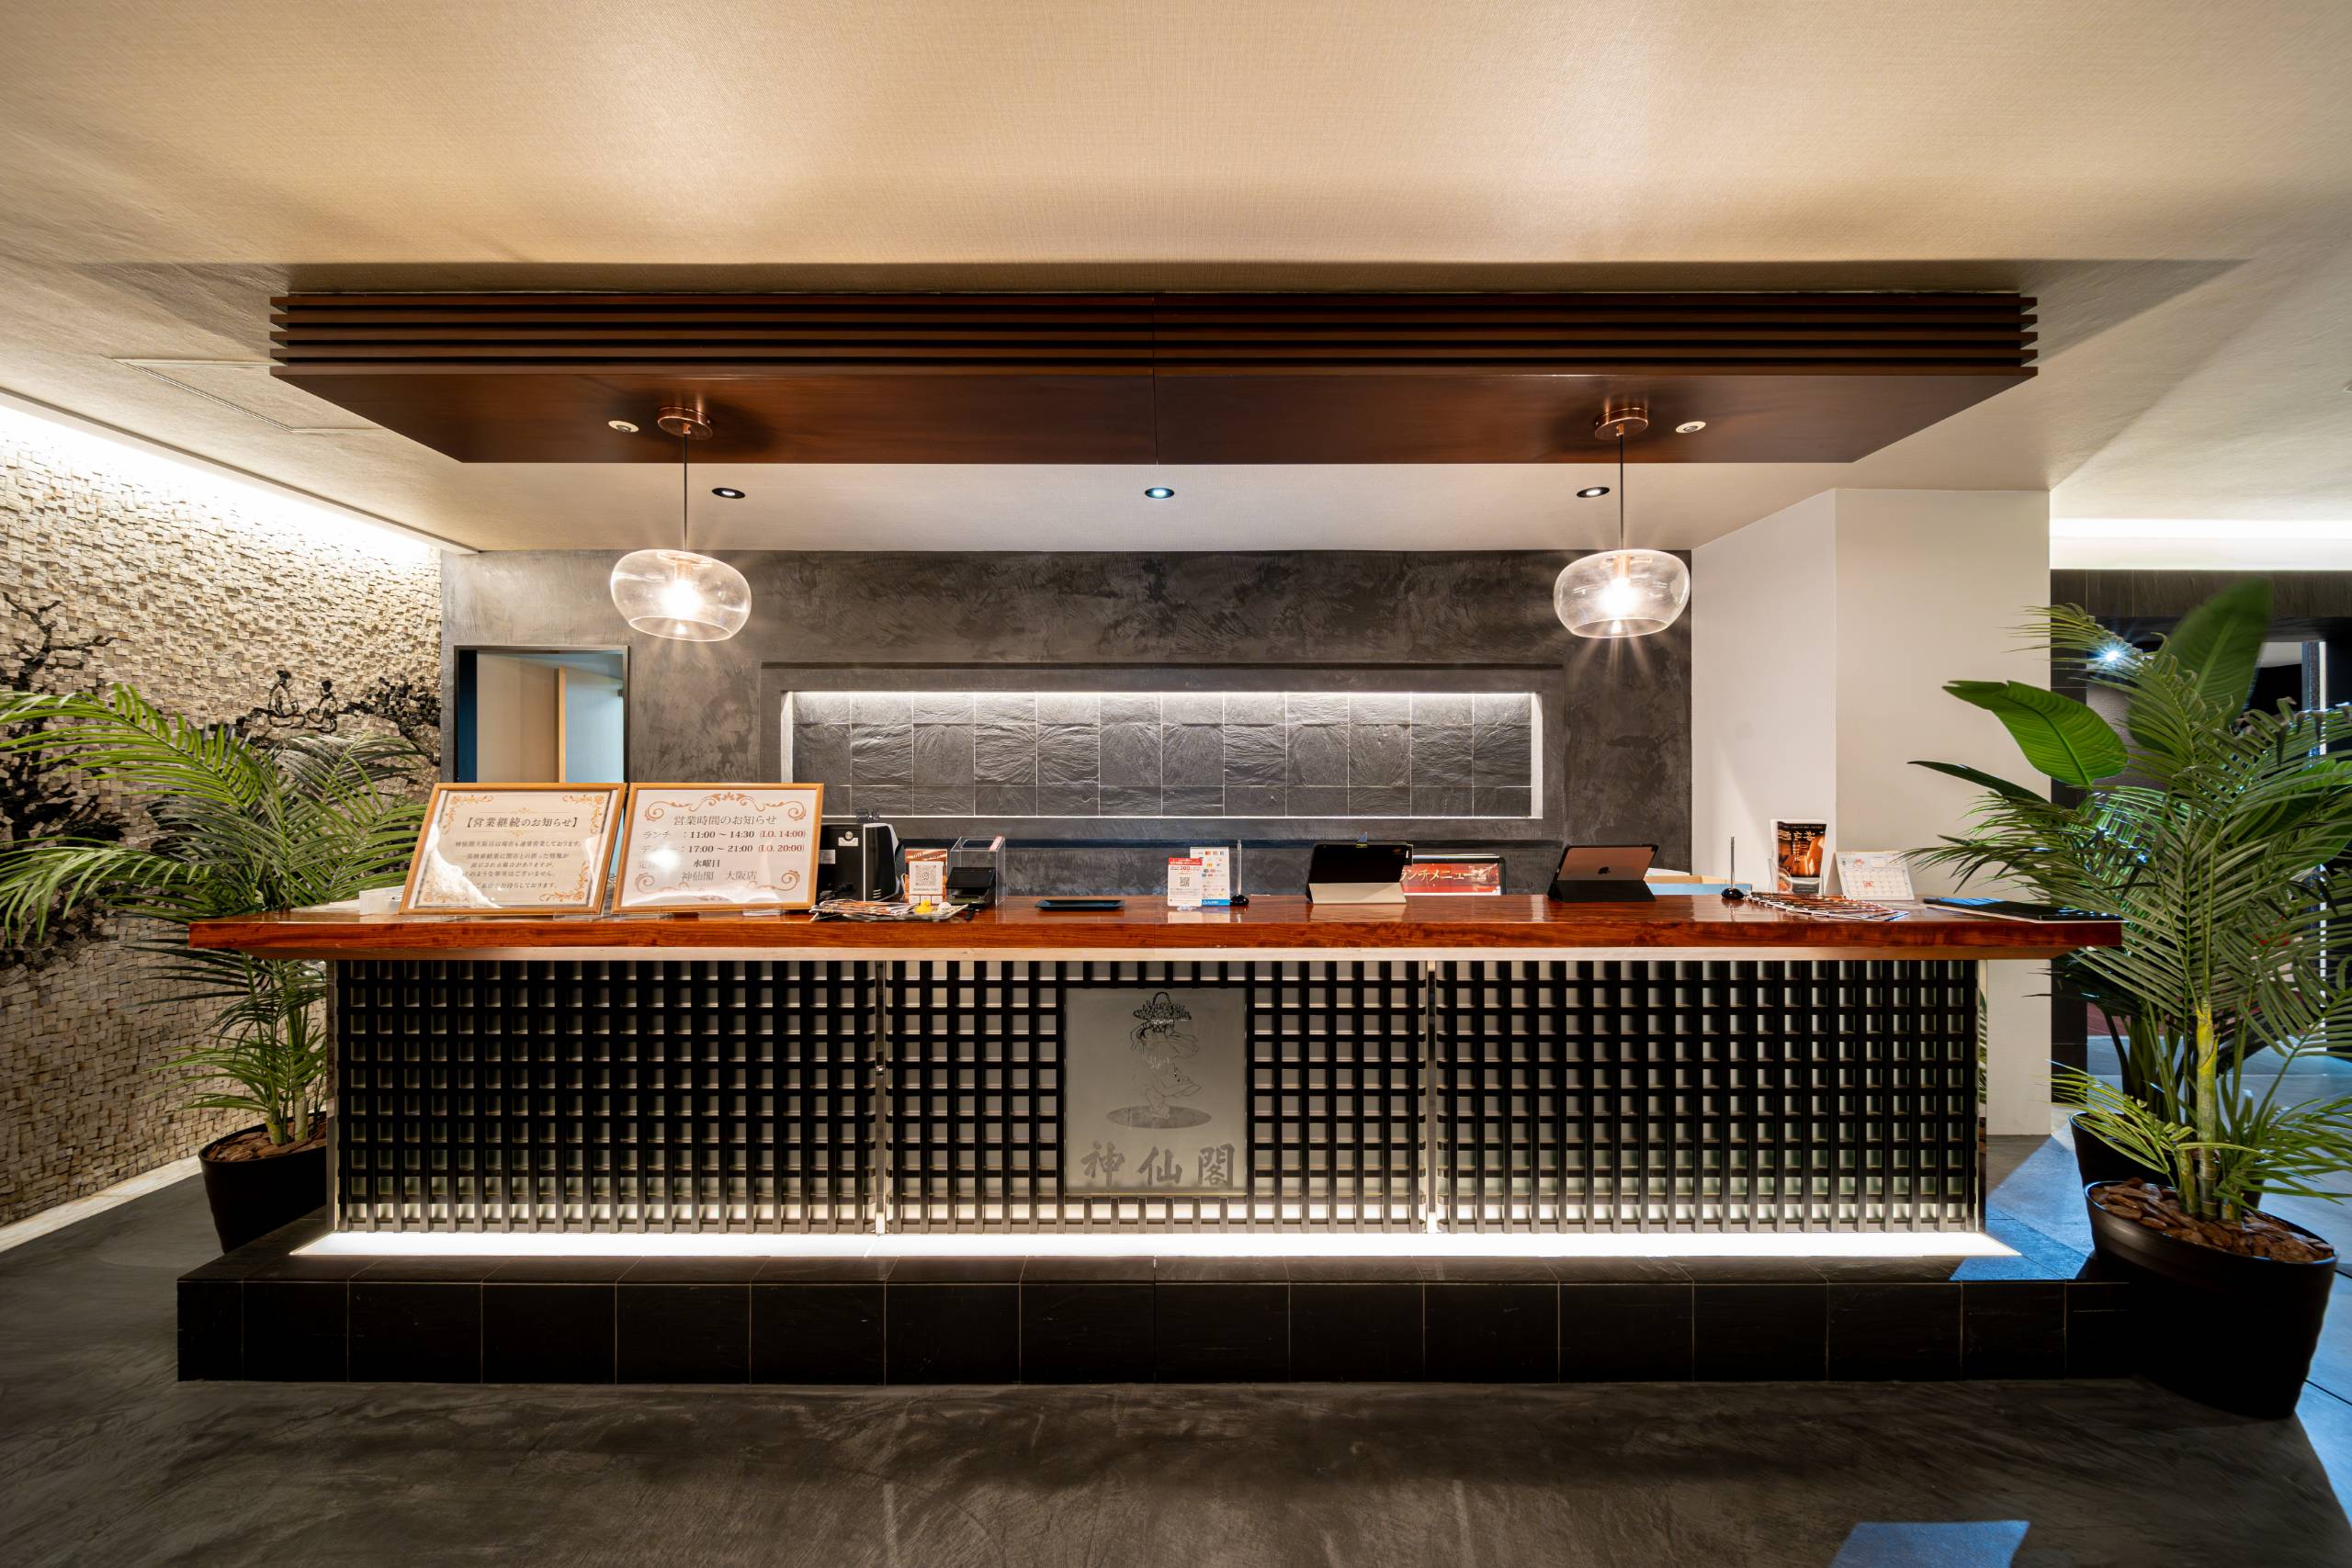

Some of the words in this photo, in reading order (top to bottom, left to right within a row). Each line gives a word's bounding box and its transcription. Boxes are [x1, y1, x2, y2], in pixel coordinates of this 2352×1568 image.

[465, 817, 579, 828] 【営業継続のお知らせ】
[673, 815, 777, 826] 営業時間のお知らせ
[693, 859, 720, 867] 水曜日
[682, 871, 714, 881] 神仙閣
[726, 870, 757, 881] 大阪店
[1080, 1140, 1236, 1190] 神仙閣
